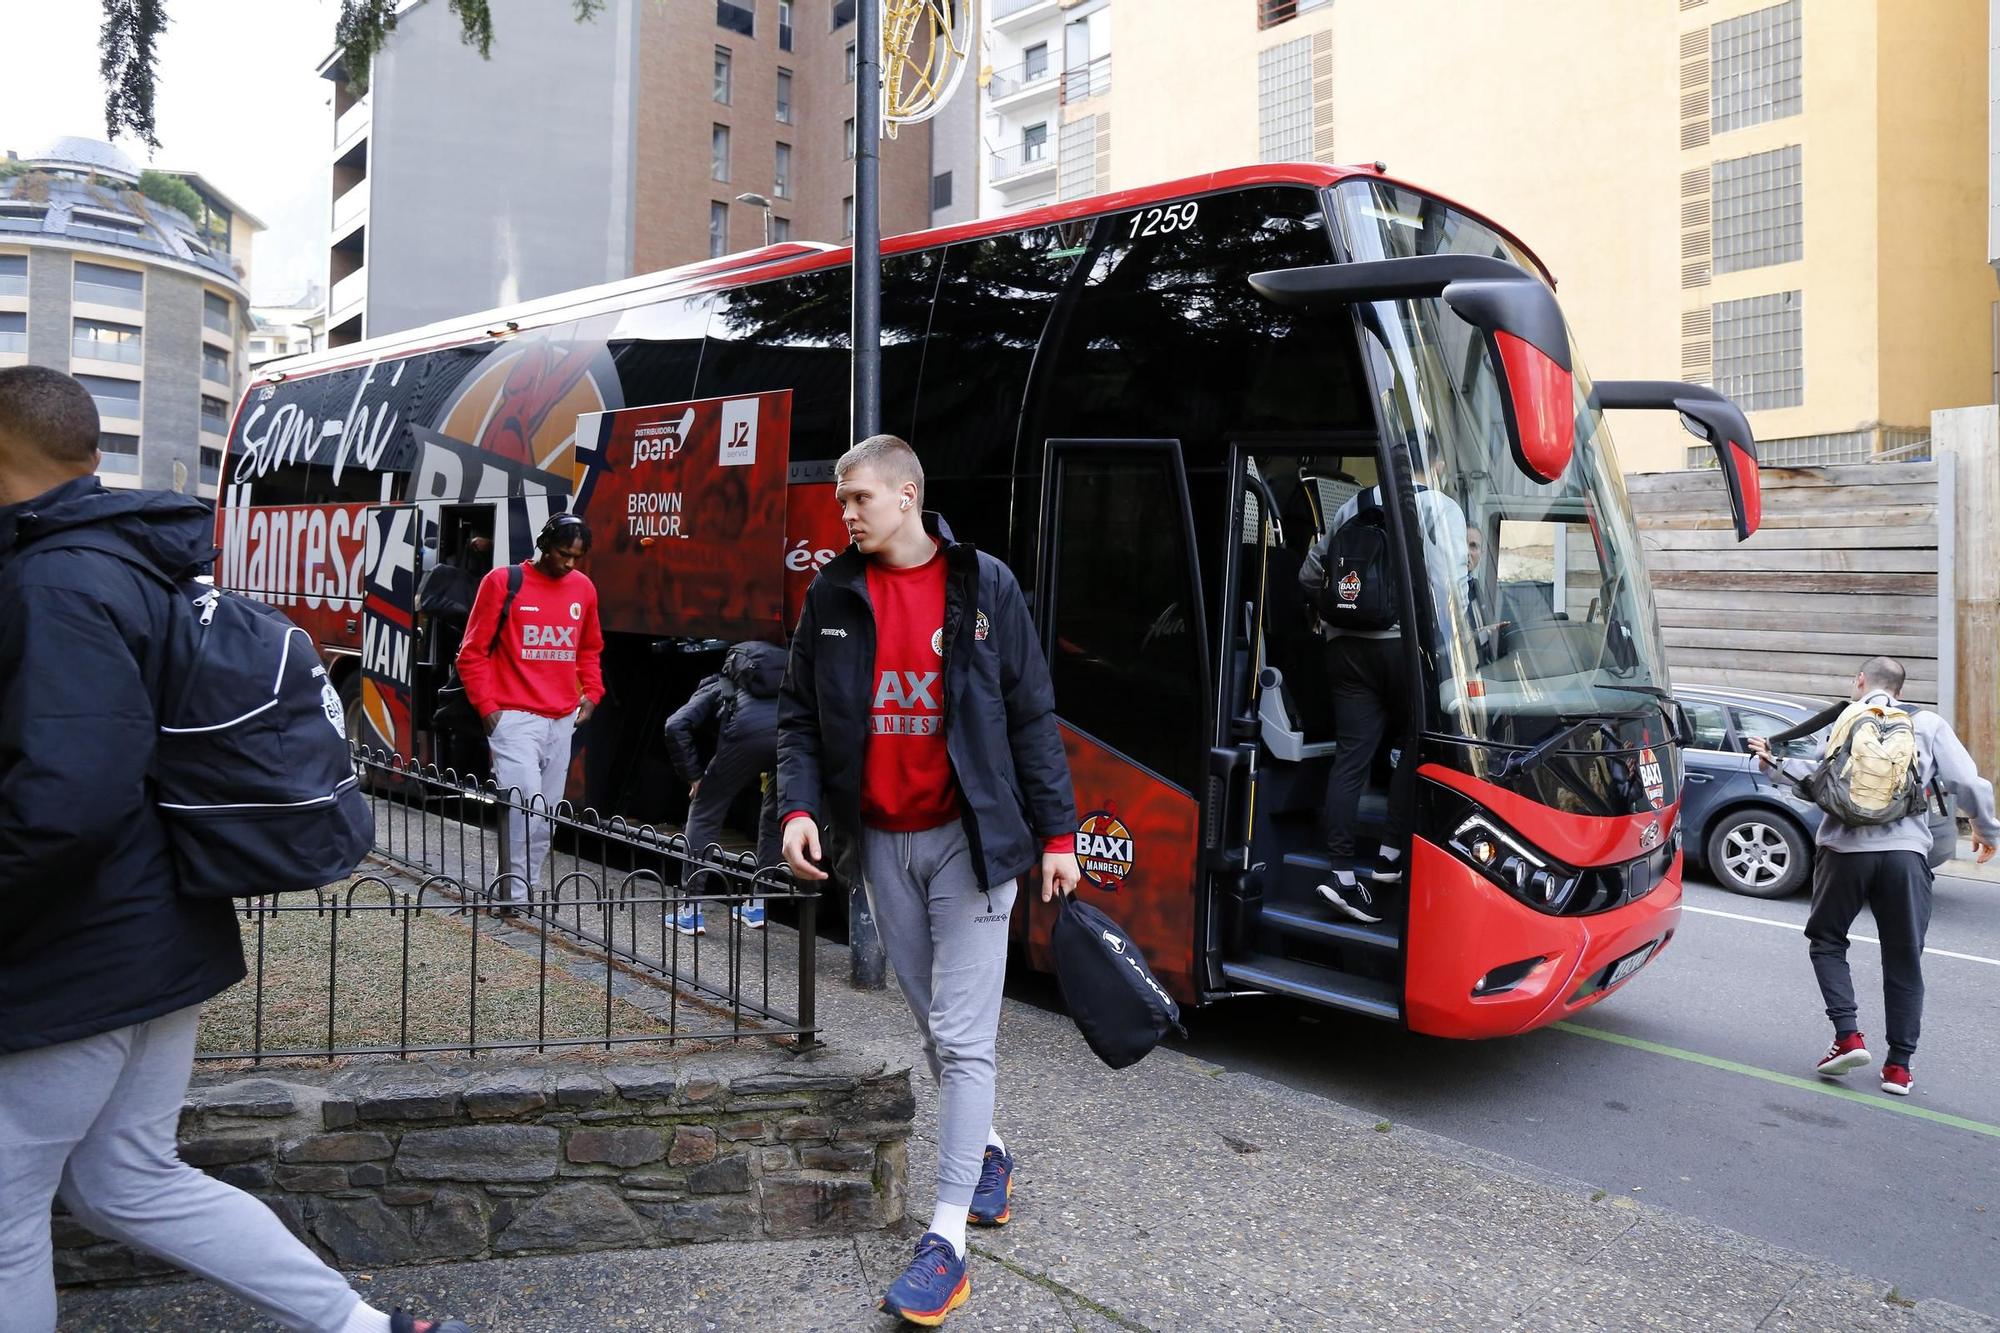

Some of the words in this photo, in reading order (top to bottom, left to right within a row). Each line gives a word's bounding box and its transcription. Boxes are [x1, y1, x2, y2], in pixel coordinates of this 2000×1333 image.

[1129, 201, 1199, 239] 1259
[635, 426, 675, 437] DISTRIBUIDORA
[628, 492, 682, 513] BROWN
[222, 472, 392, 613] Manresa
[1340, 582, 1361, 590] BAXI
[523, 625, 577, 647] BAX
[362, 612, 412, 687] MAN
[873, 670, 940, 709] AX
[871, 715, 943, 734] ANRESA
[1640, 762, 1663, 787] BAXI
[1076, 832, 1133, 862] BAXI
[1086, 859, 1124, 877] MANRESA
